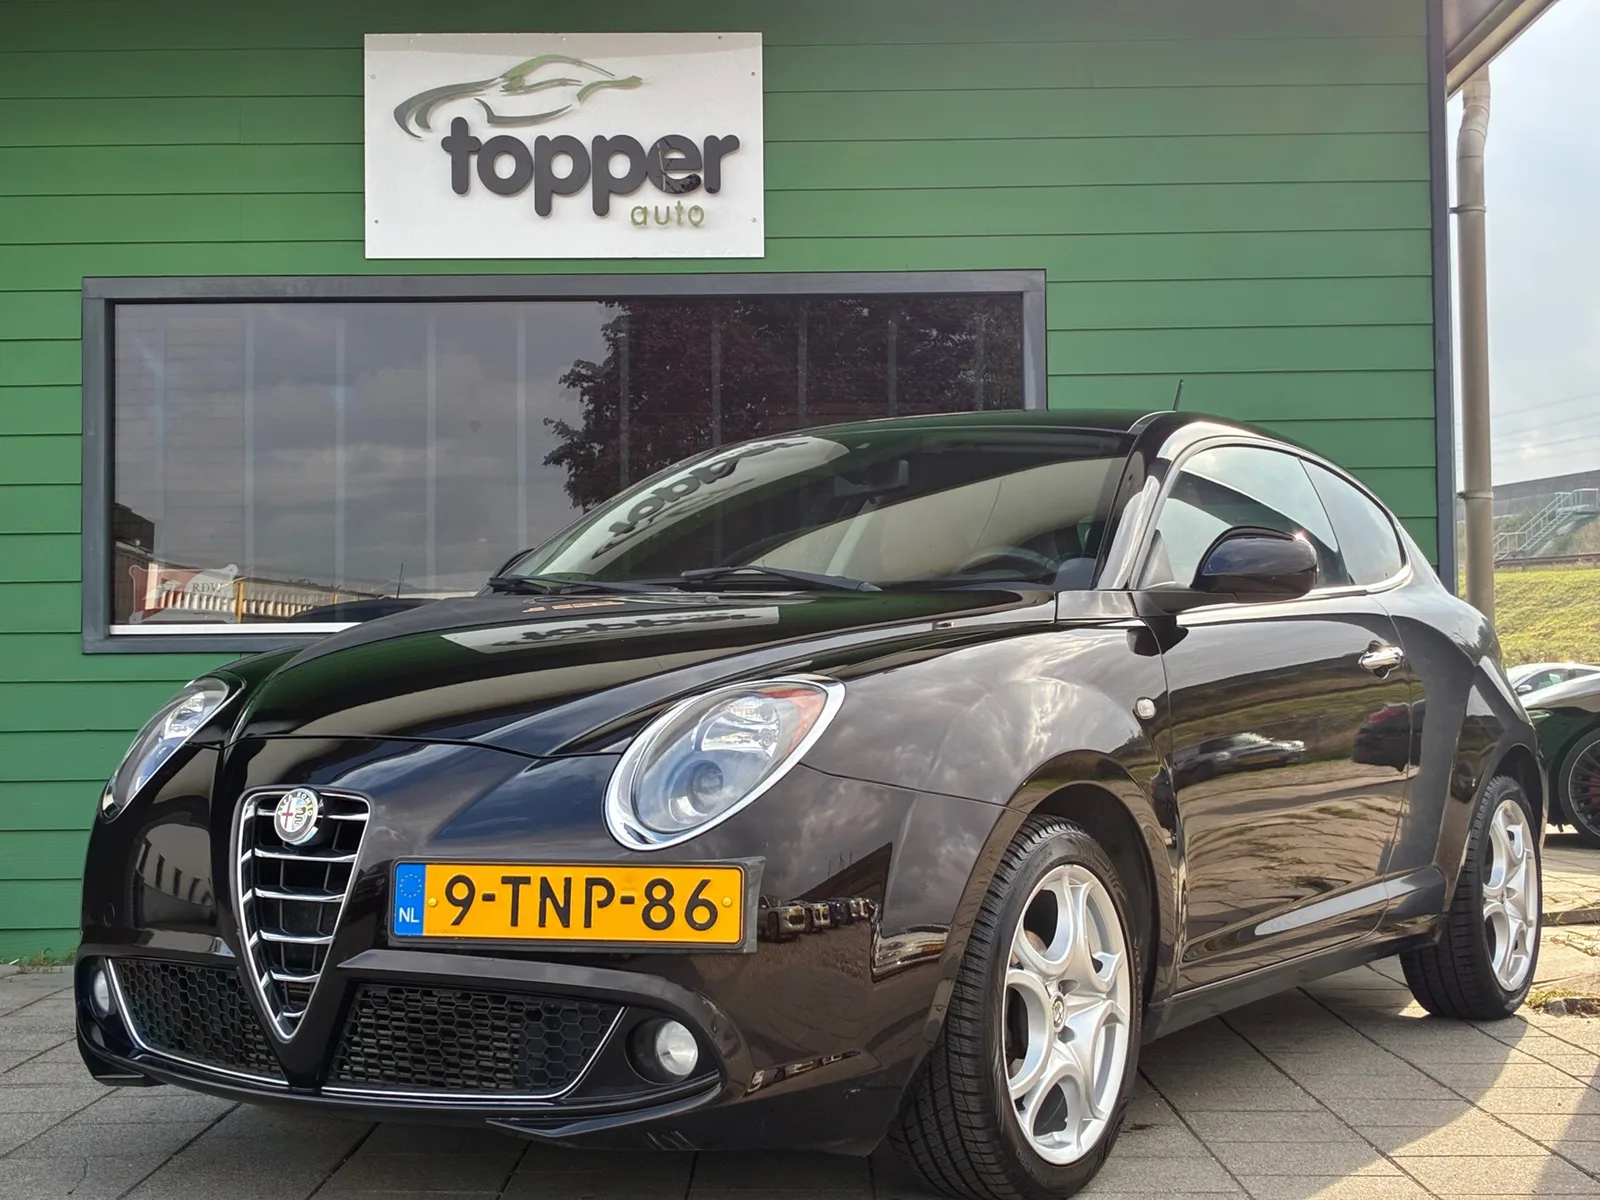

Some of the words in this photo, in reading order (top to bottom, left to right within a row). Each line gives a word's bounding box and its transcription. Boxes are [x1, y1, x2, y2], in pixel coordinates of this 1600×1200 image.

[441, 116, 740, 217] topper
[630, 200, 705, 227] auto
[192, 582, 222, 592] RDW
[399, 906, 420, 924] NL
[444, 873, 719, 931] 9-TNP-86
